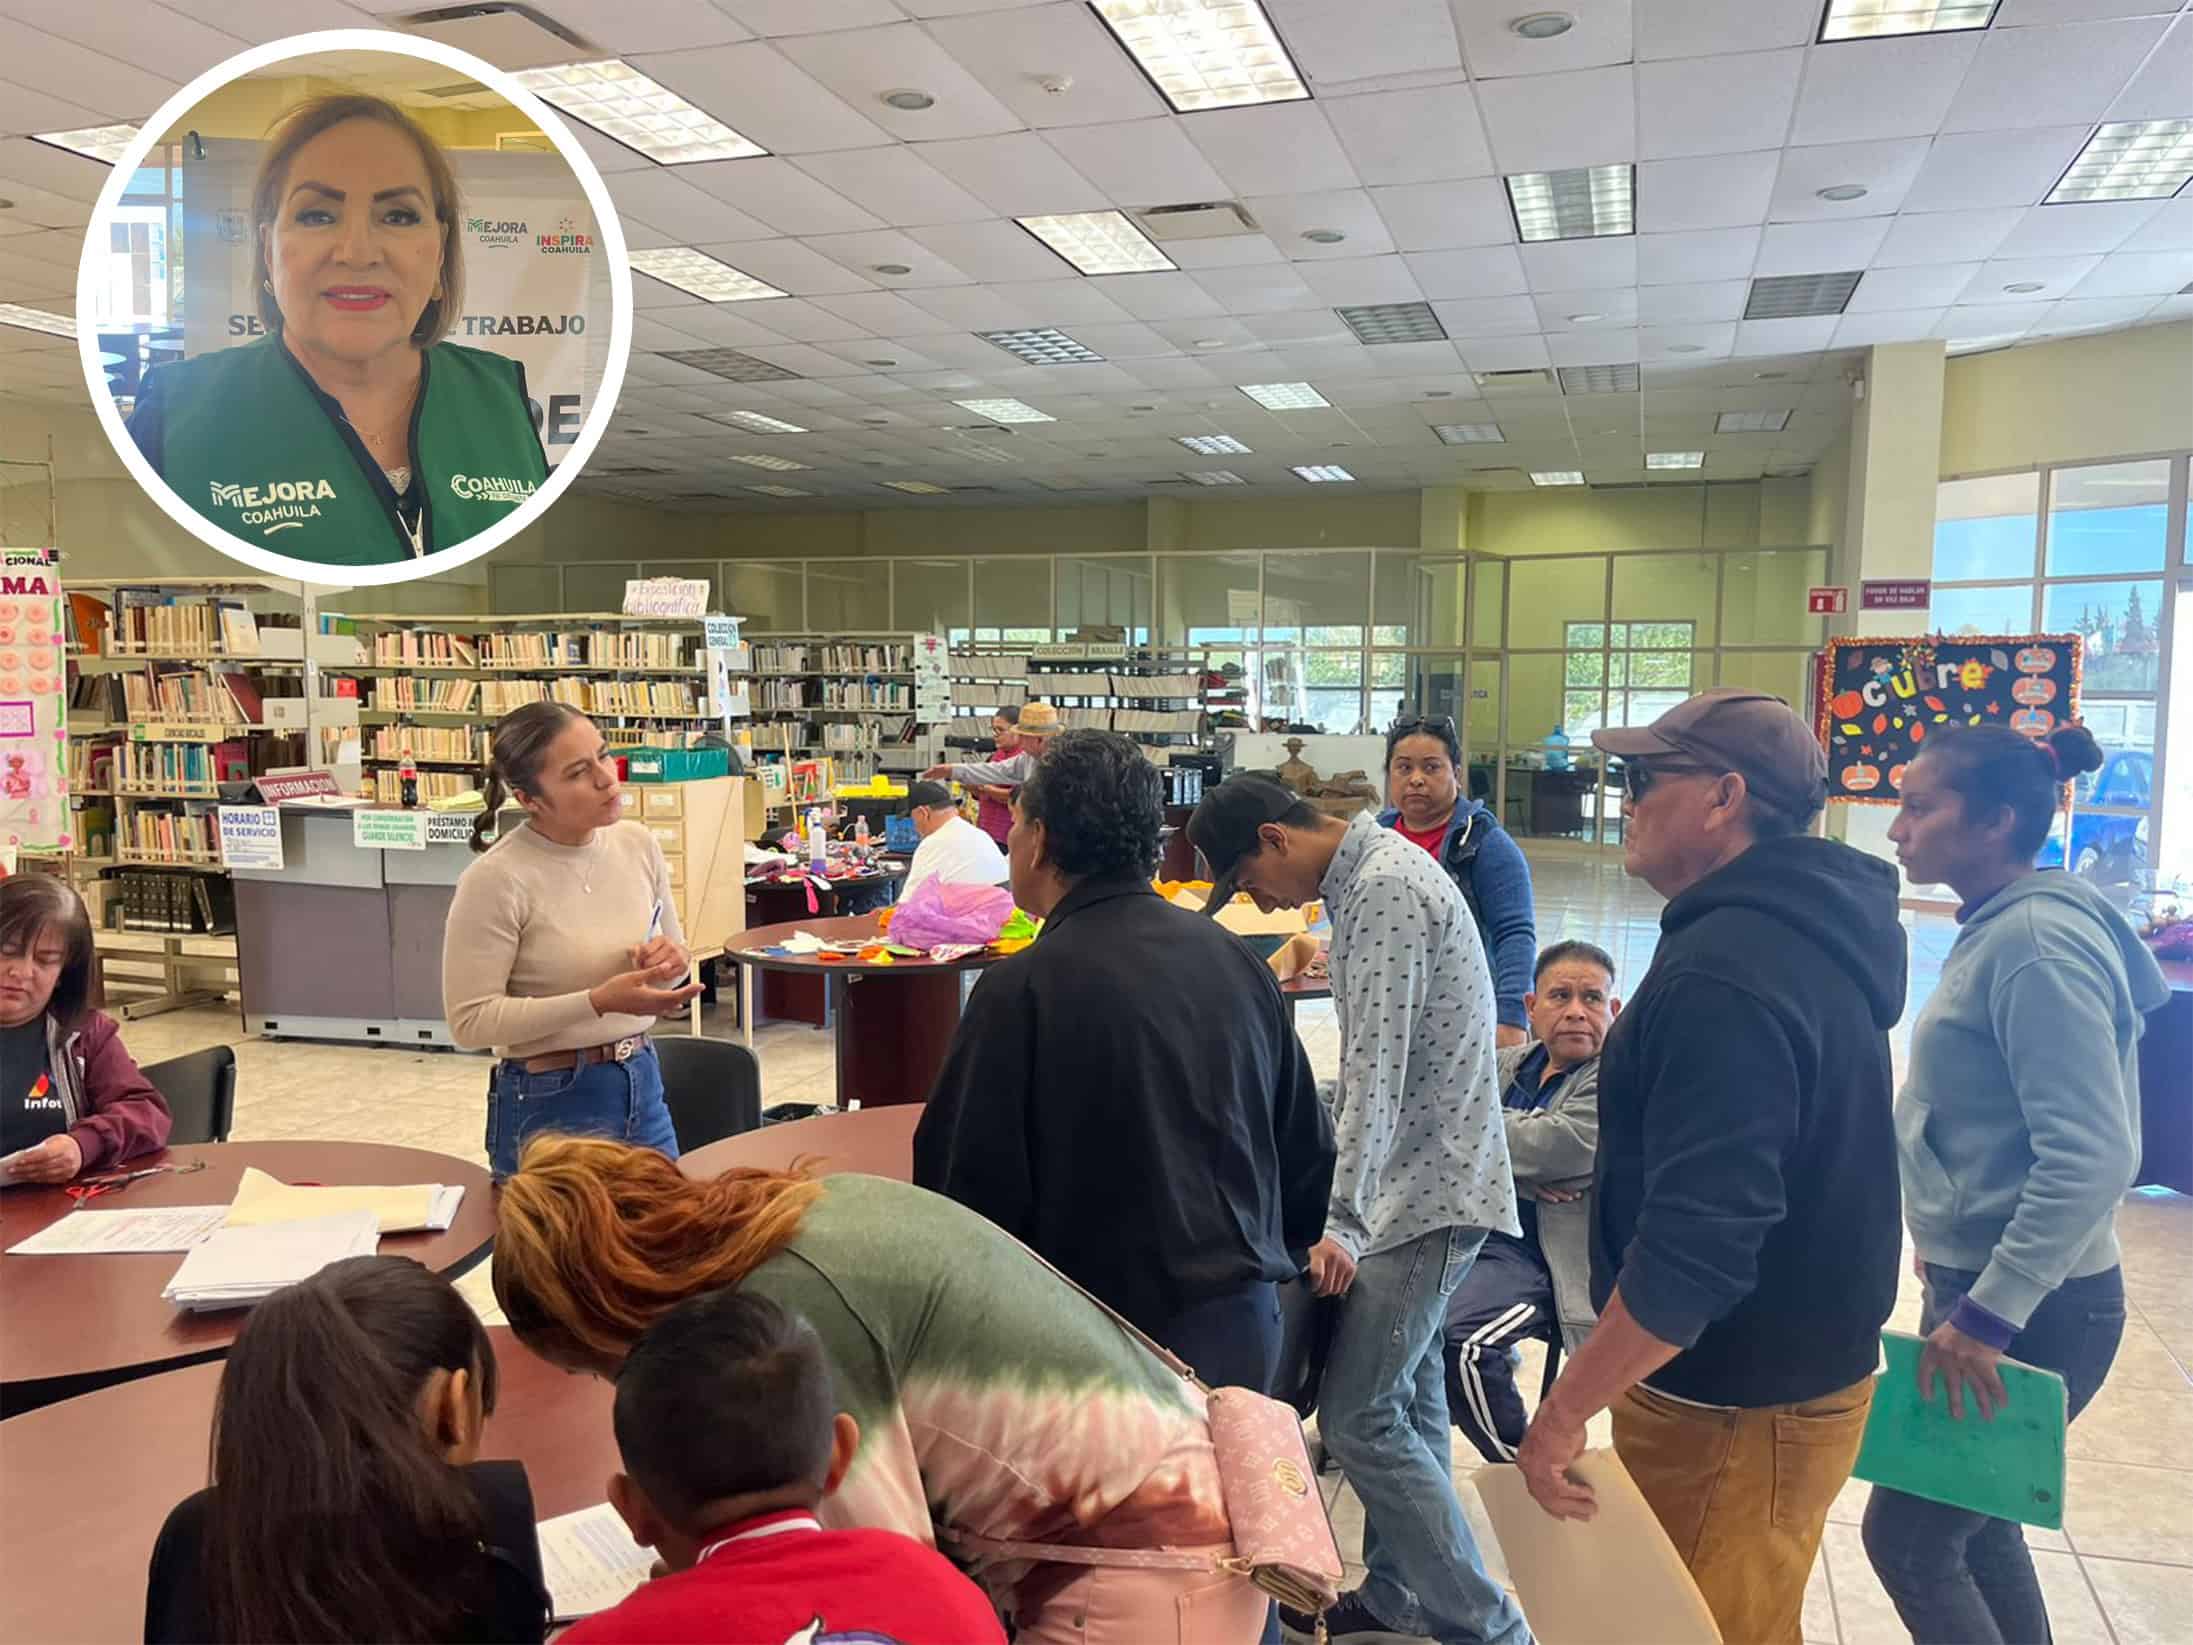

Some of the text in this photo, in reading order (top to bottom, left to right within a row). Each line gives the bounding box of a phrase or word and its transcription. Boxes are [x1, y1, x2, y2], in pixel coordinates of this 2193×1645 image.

[467, 218, 528, 233] MEJORA
[480, 235, 519, 243] COAHUILA
[536, 234, 594, 246] INSPIRA
[541, 246, 591, 254] COAHUILA
[462, 315, 585, 336] TRABAJO
[210, 479, 336, 508] MEJORA
[451, 474, 537, 498] COAHUILA
[241, 504, 321, 524] COAHUILA
[0, 577, 48, 594] MA
[222, 812, 261, 824] HORARIO
[223, 826, 276, 837] DE SERVICIO
